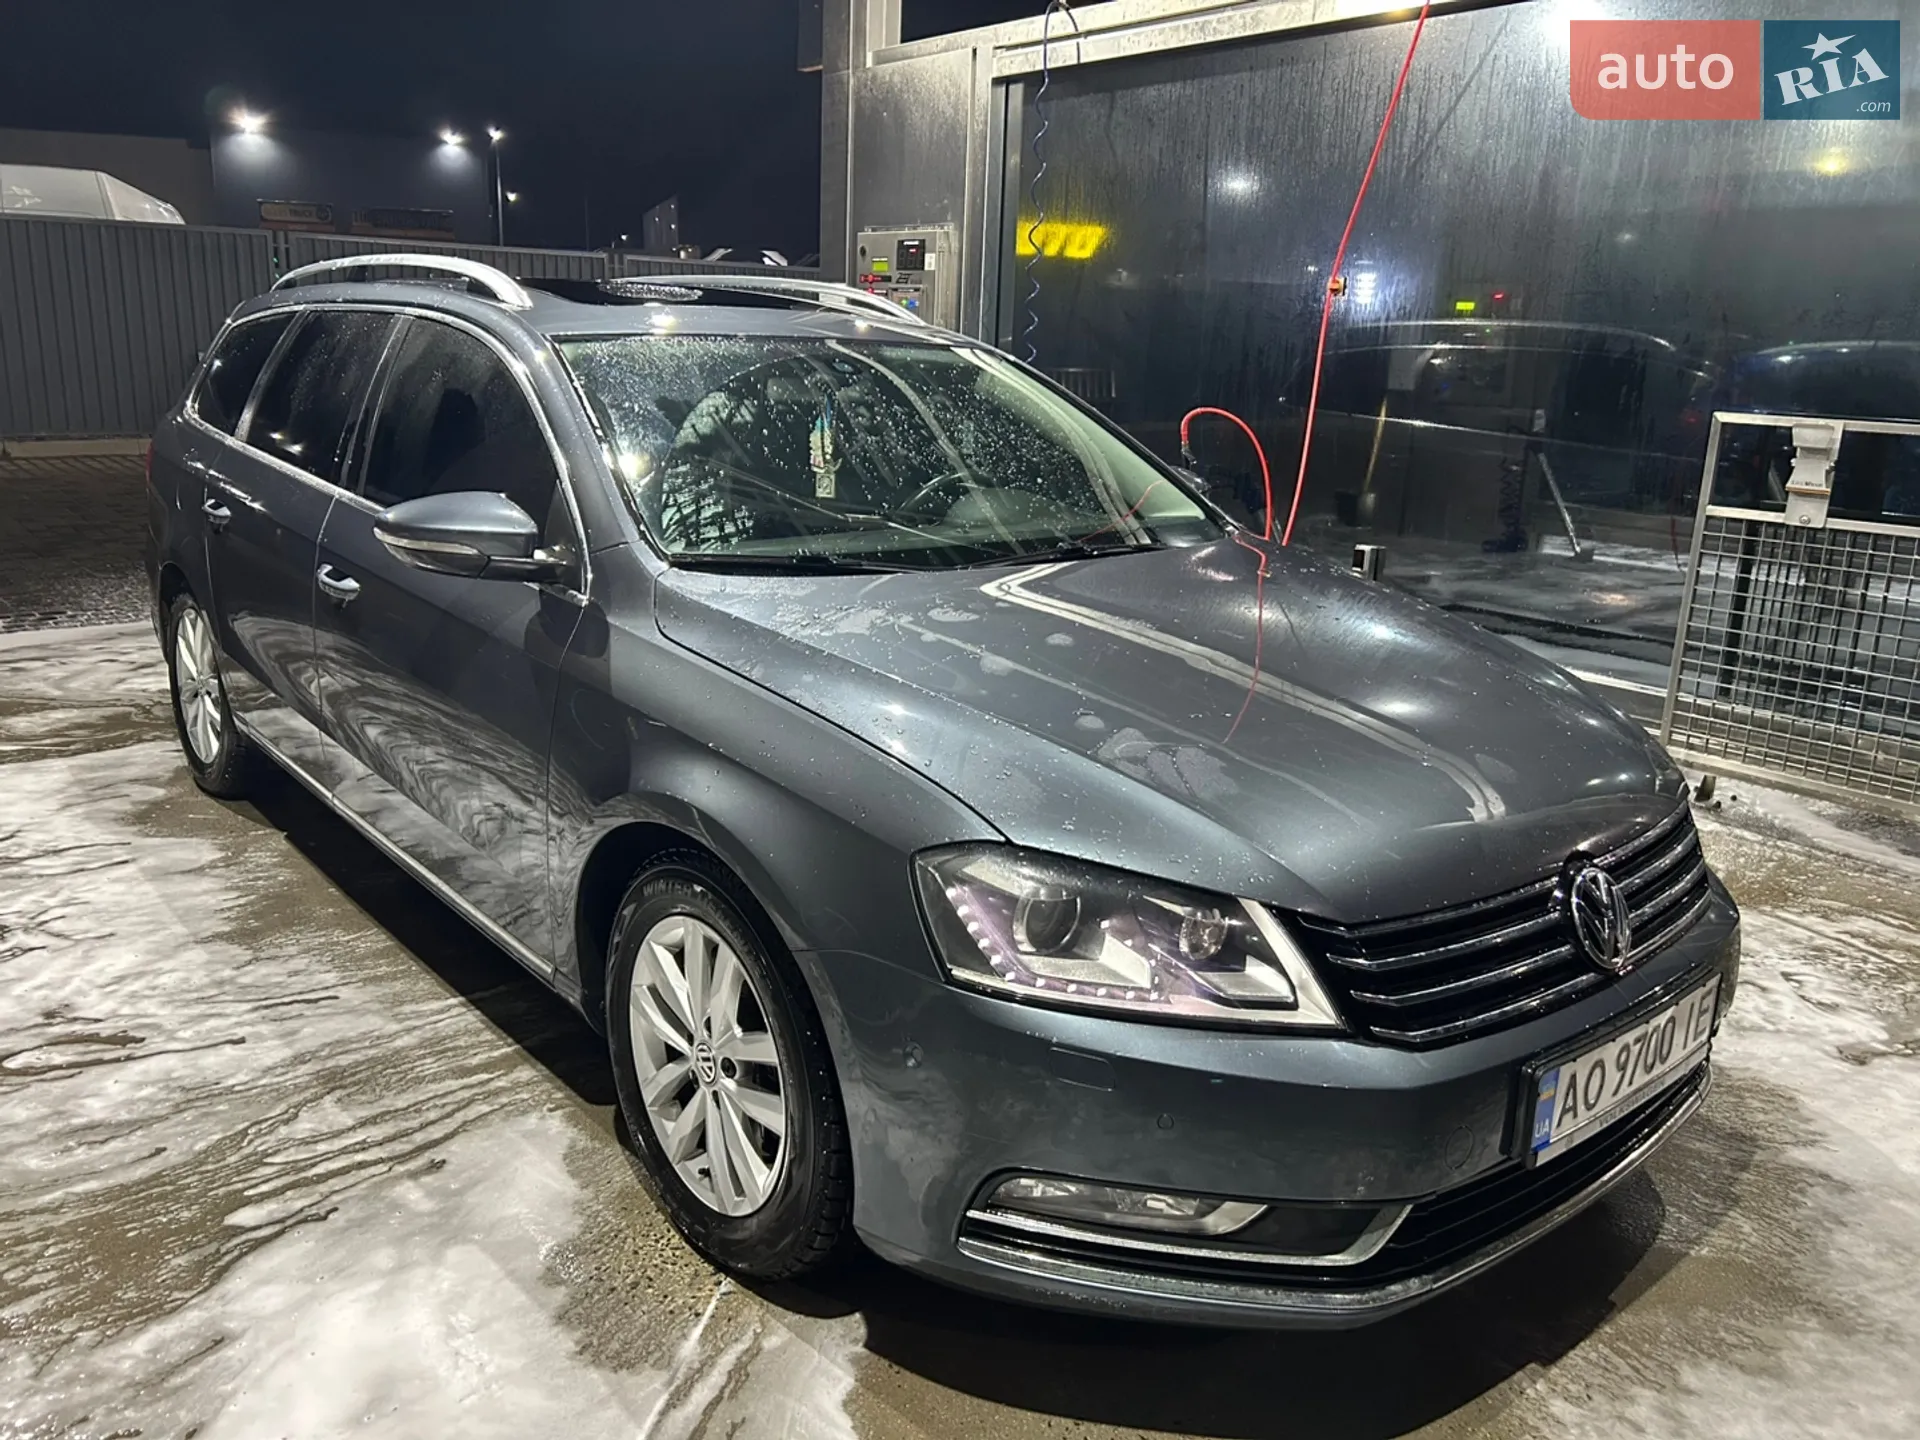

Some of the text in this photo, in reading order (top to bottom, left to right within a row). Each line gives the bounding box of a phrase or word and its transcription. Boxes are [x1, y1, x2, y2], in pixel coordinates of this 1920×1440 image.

[642, 879, 692, 898] WINTER
[1555, 988, 1715, 1129] AO 9700 IE
[1534, 1121, 1550, 1138] UA
